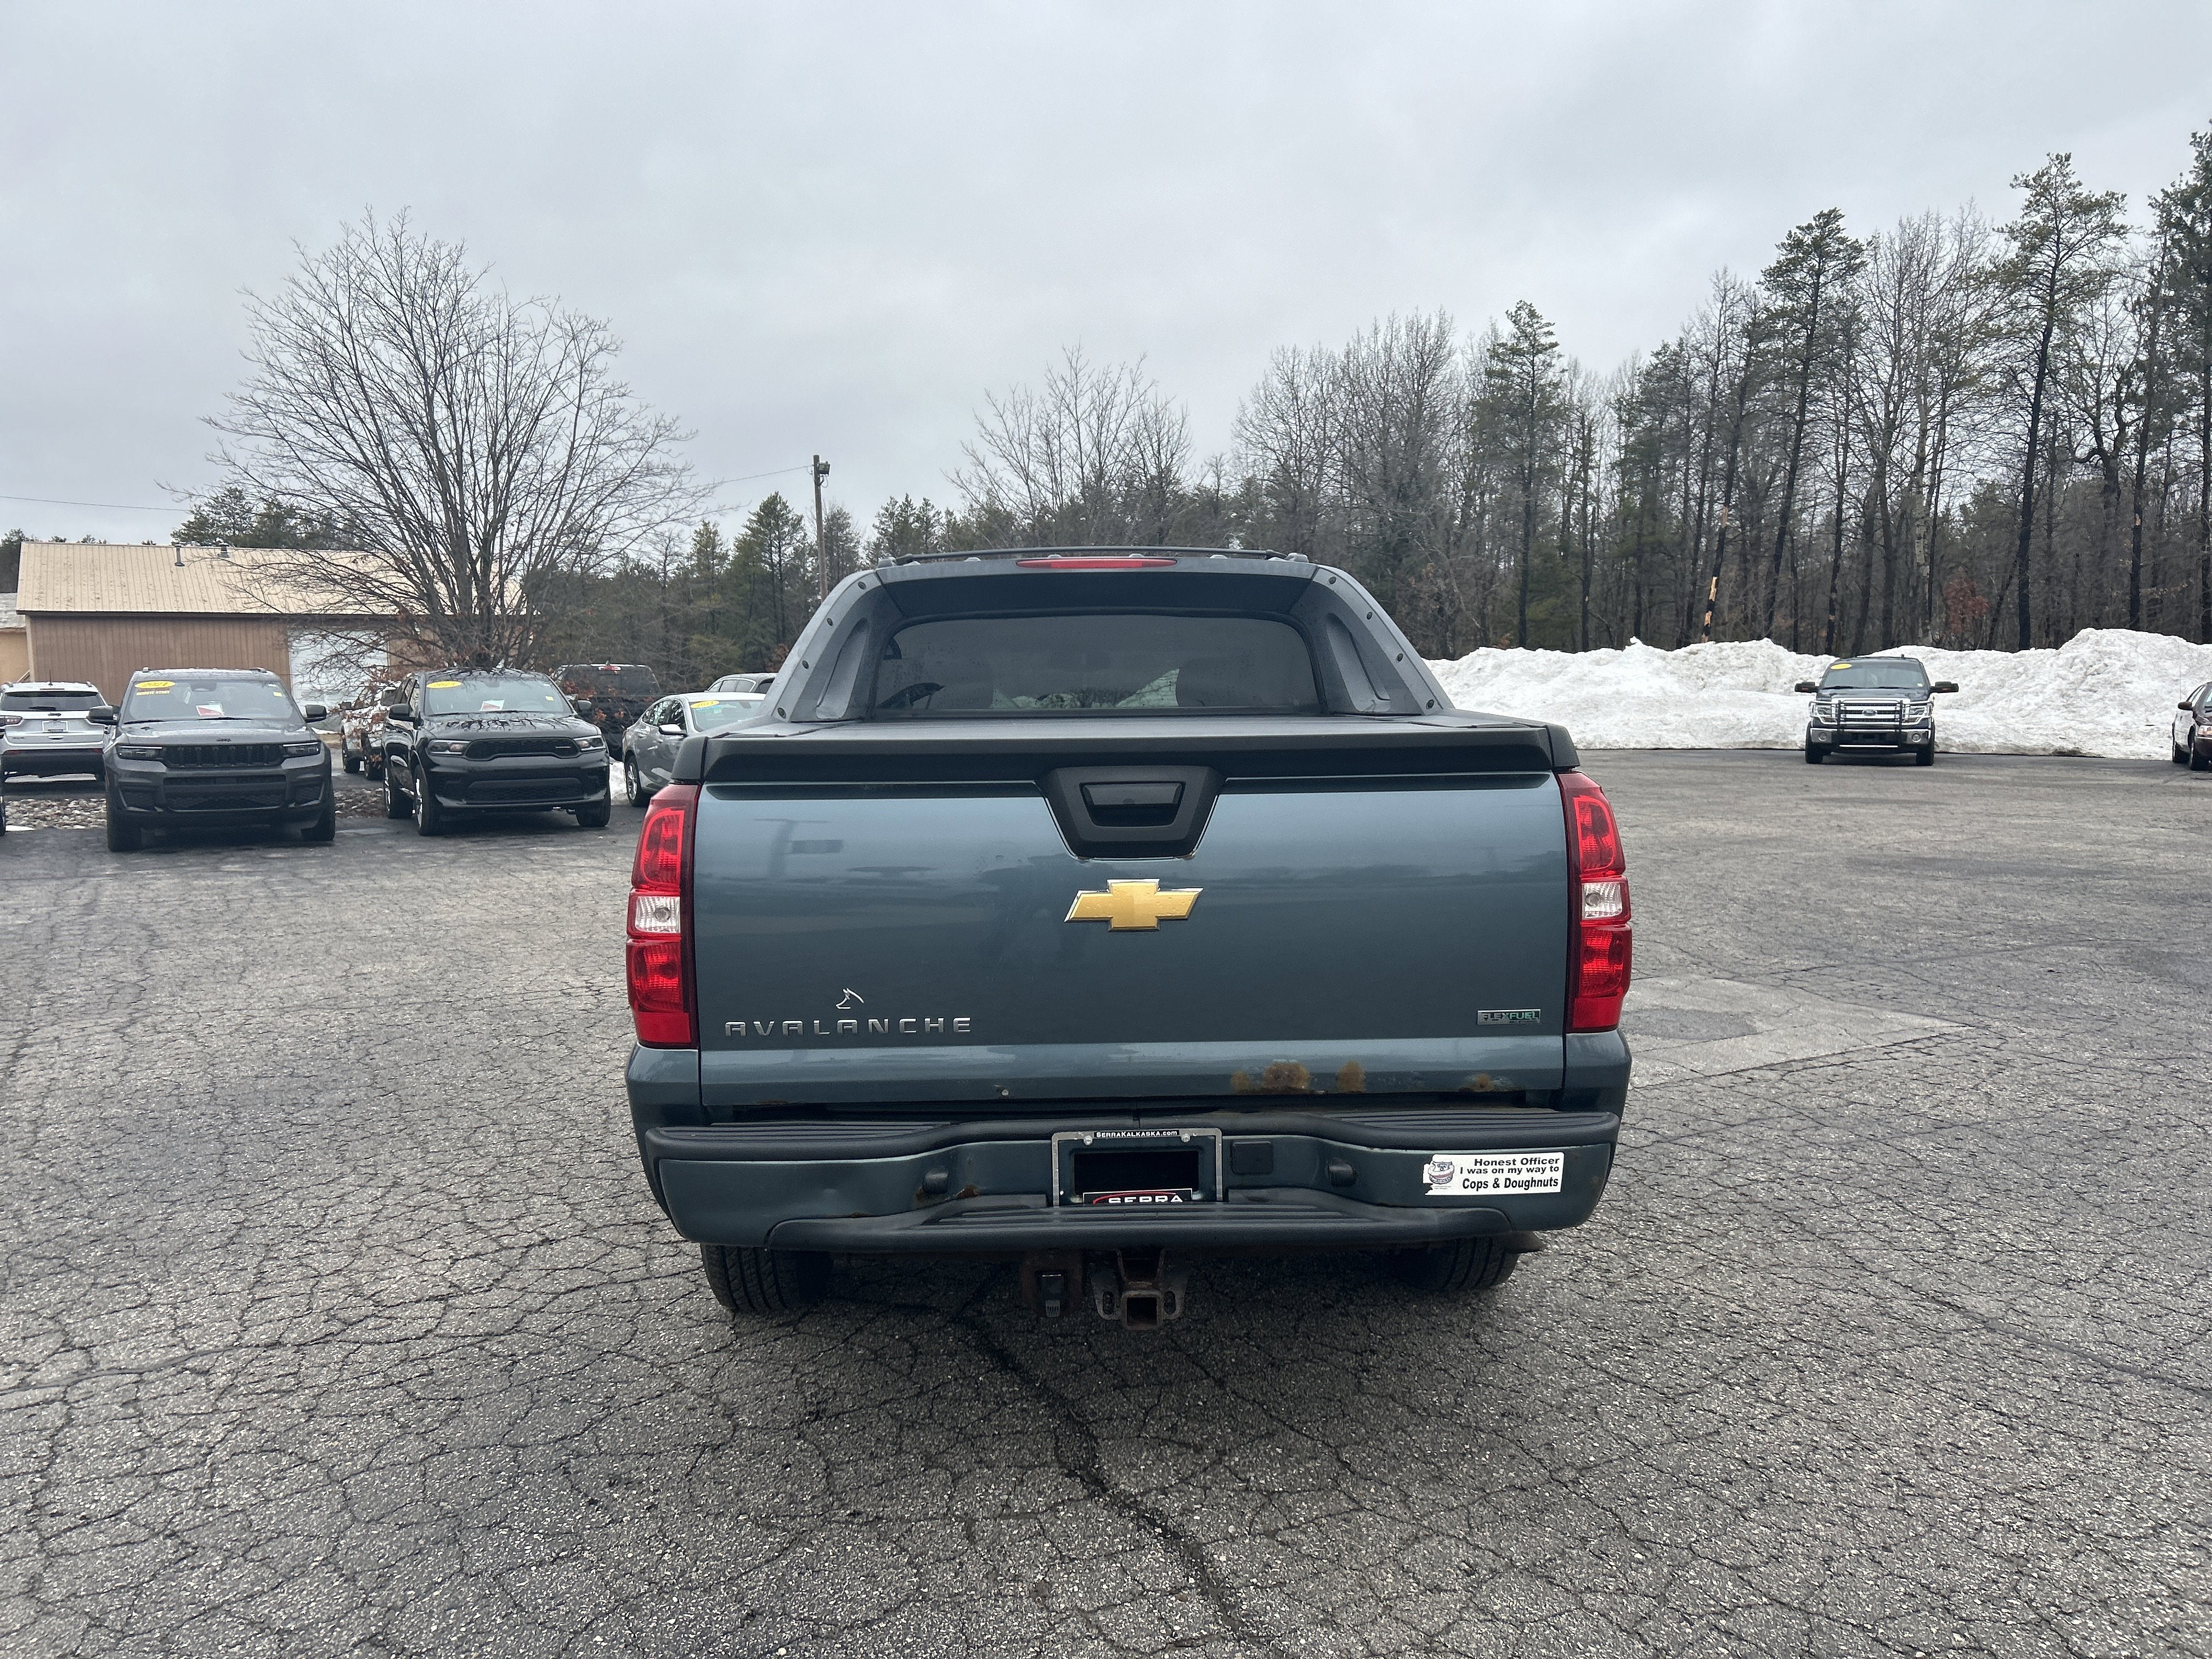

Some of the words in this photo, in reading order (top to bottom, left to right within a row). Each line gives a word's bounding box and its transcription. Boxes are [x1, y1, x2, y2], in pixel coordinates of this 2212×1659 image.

[724, 1017, 972, 1037] AVALANCHE
[1520, 1157, 1560, 1165] Officer
[1463, 1178, 1488, 1192] Cops
[1492, 1177, 1500, 1189] &
[1504, 1176, 1559, 1190] Doughnuts
